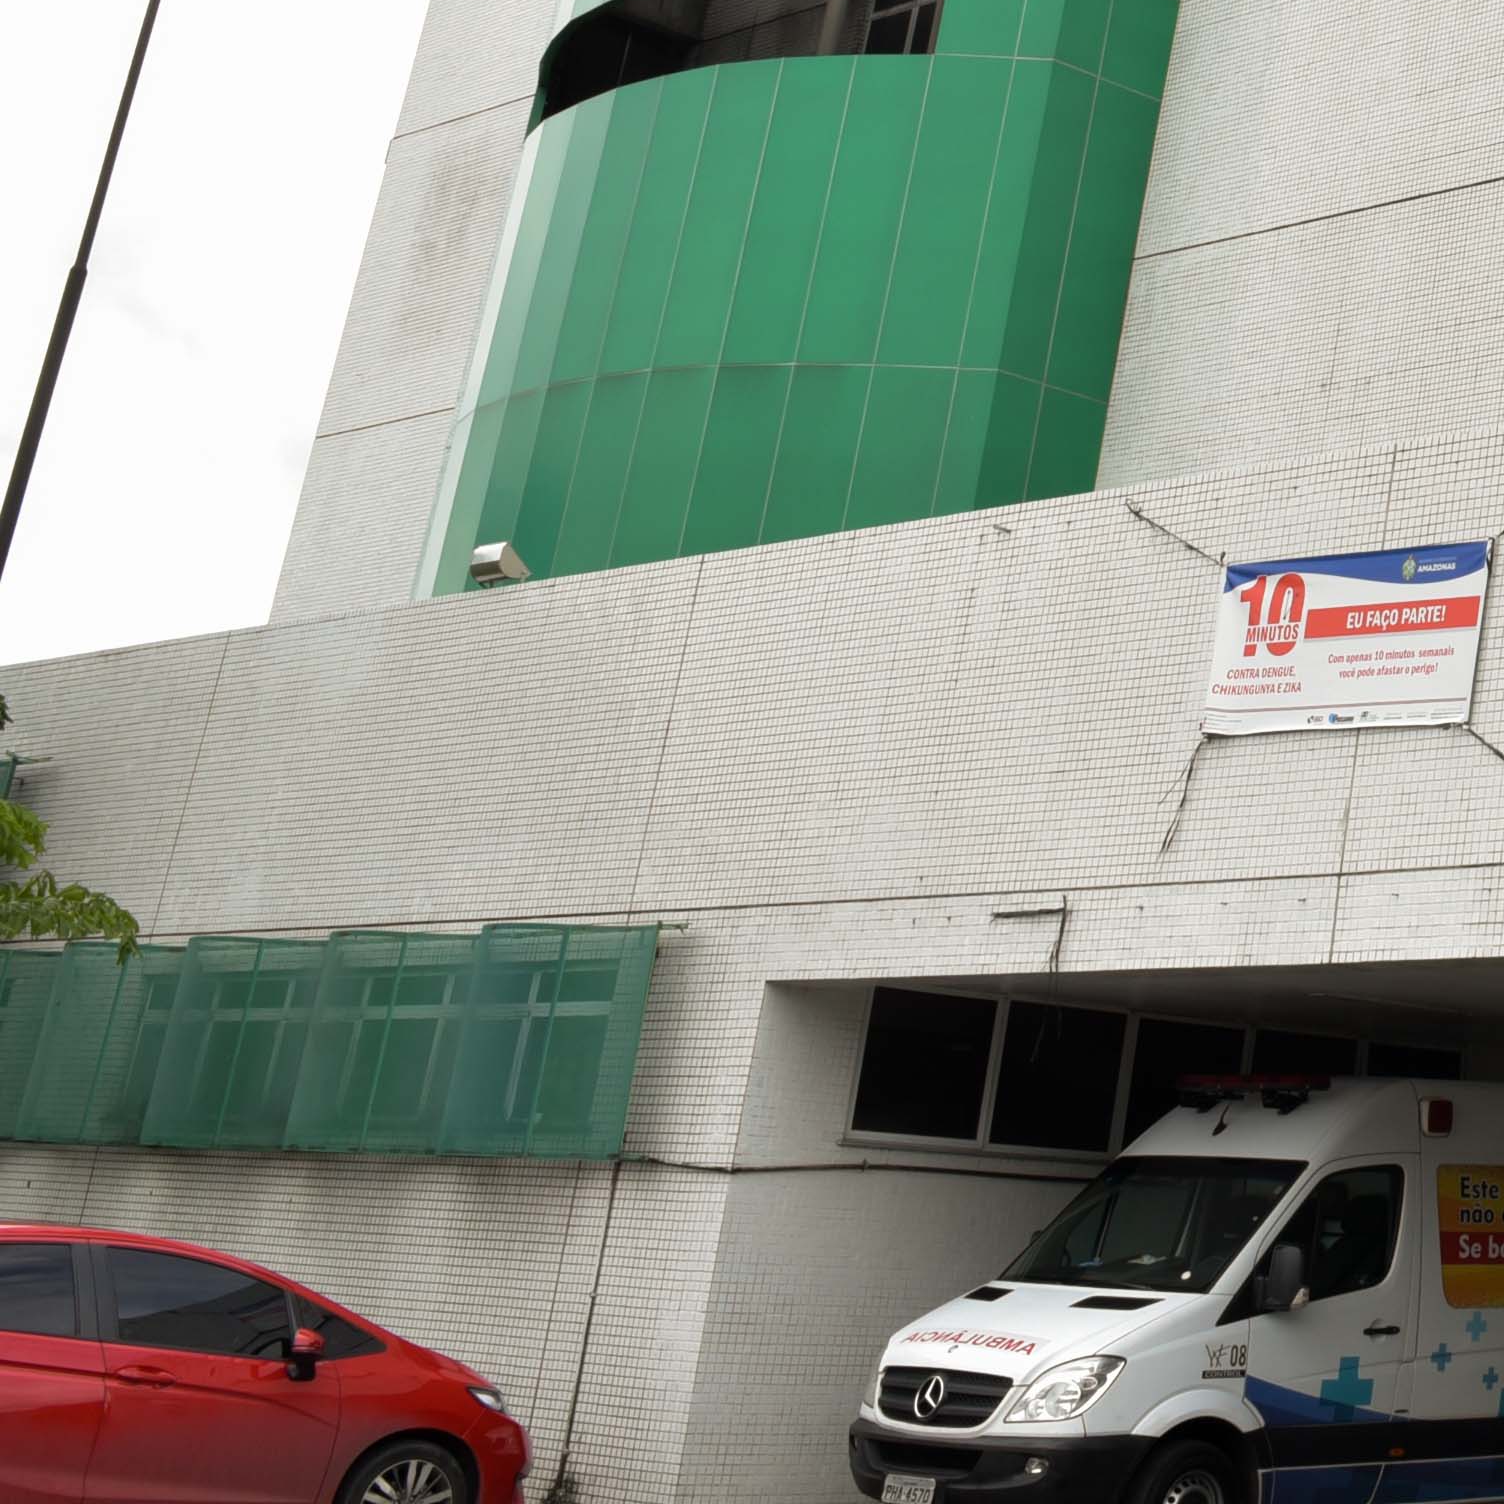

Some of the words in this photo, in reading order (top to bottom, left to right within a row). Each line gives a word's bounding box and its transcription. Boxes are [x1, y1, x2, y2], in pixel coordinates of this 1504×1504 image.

[1240, 572, 1305, 656] 10
[1346, 612, 1363, 629] EU
[1366, 609, 1399, 631] FAÇO
[1401, 605, 1446, 625] PARTE!
[1246, 624, 1299, 643] MINUTOS
[1328, 653, 1344, 664] Com
[1346, 653, 1372, 664] apenas
[1374, 650, 1383, 660] 10
[1385, 648, 1415, 660] minutos
[1418, 645, 1454, 658] semanais
[1227, 668, 1259, 679] CONTRA
[1357, 665, 1375, 678] pode
[1376, 665, 1403, 676] afastar
[1212, 683, 1275, 695] CHIKUNGUNYA
[1284, 682, 1301, 693] ZIKA
[1460, 1176, 1499, 1199] Este
[1460, 1203, 1494, 1224] não
[1459, 1234, 1481, 1258] Se
[1230, 1344, 1246, 1366] 08
